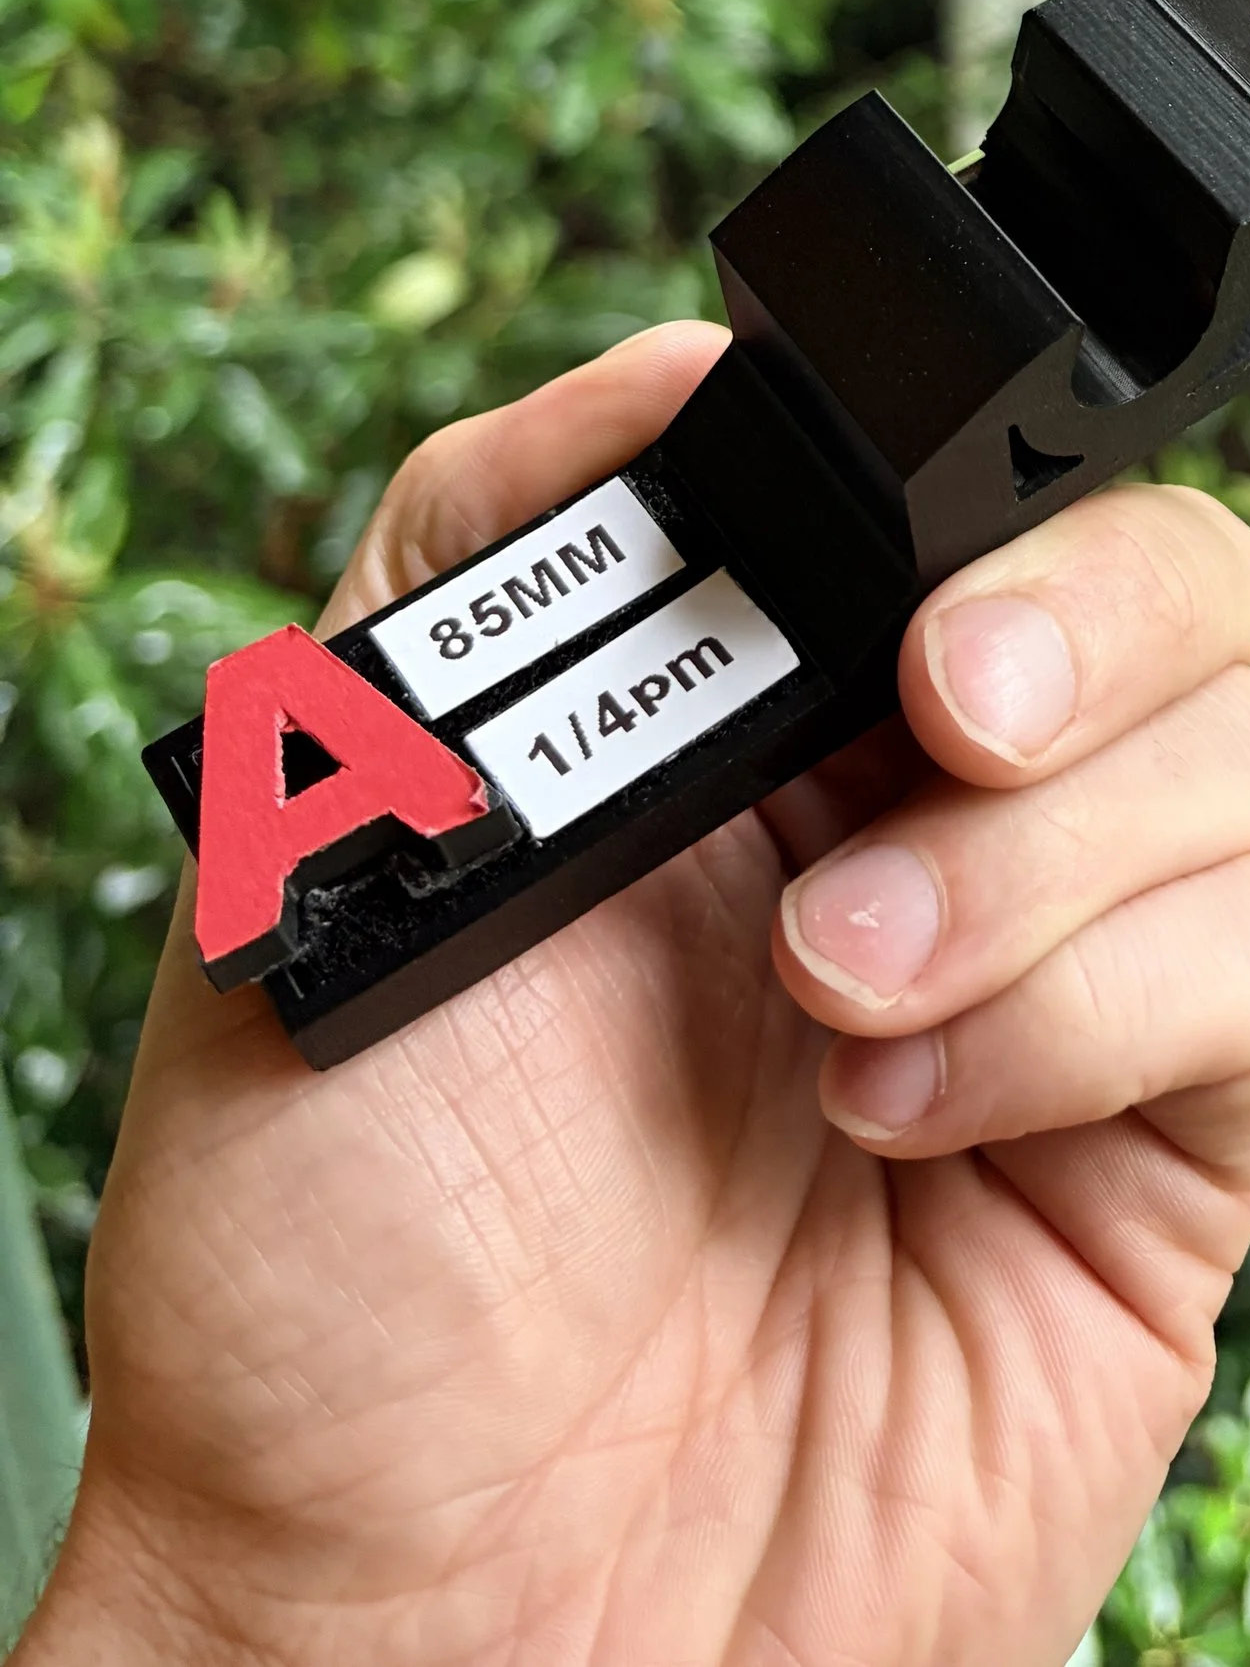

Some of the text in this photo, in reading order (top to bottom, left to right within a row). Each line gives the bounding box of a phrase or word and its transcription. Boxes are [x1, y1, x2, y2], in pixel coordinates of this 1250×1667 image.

[428, 523, 628, 662] 85MM
[526, 634, 736, 777] 1/4pm
[194, 622, 491, 964] A
